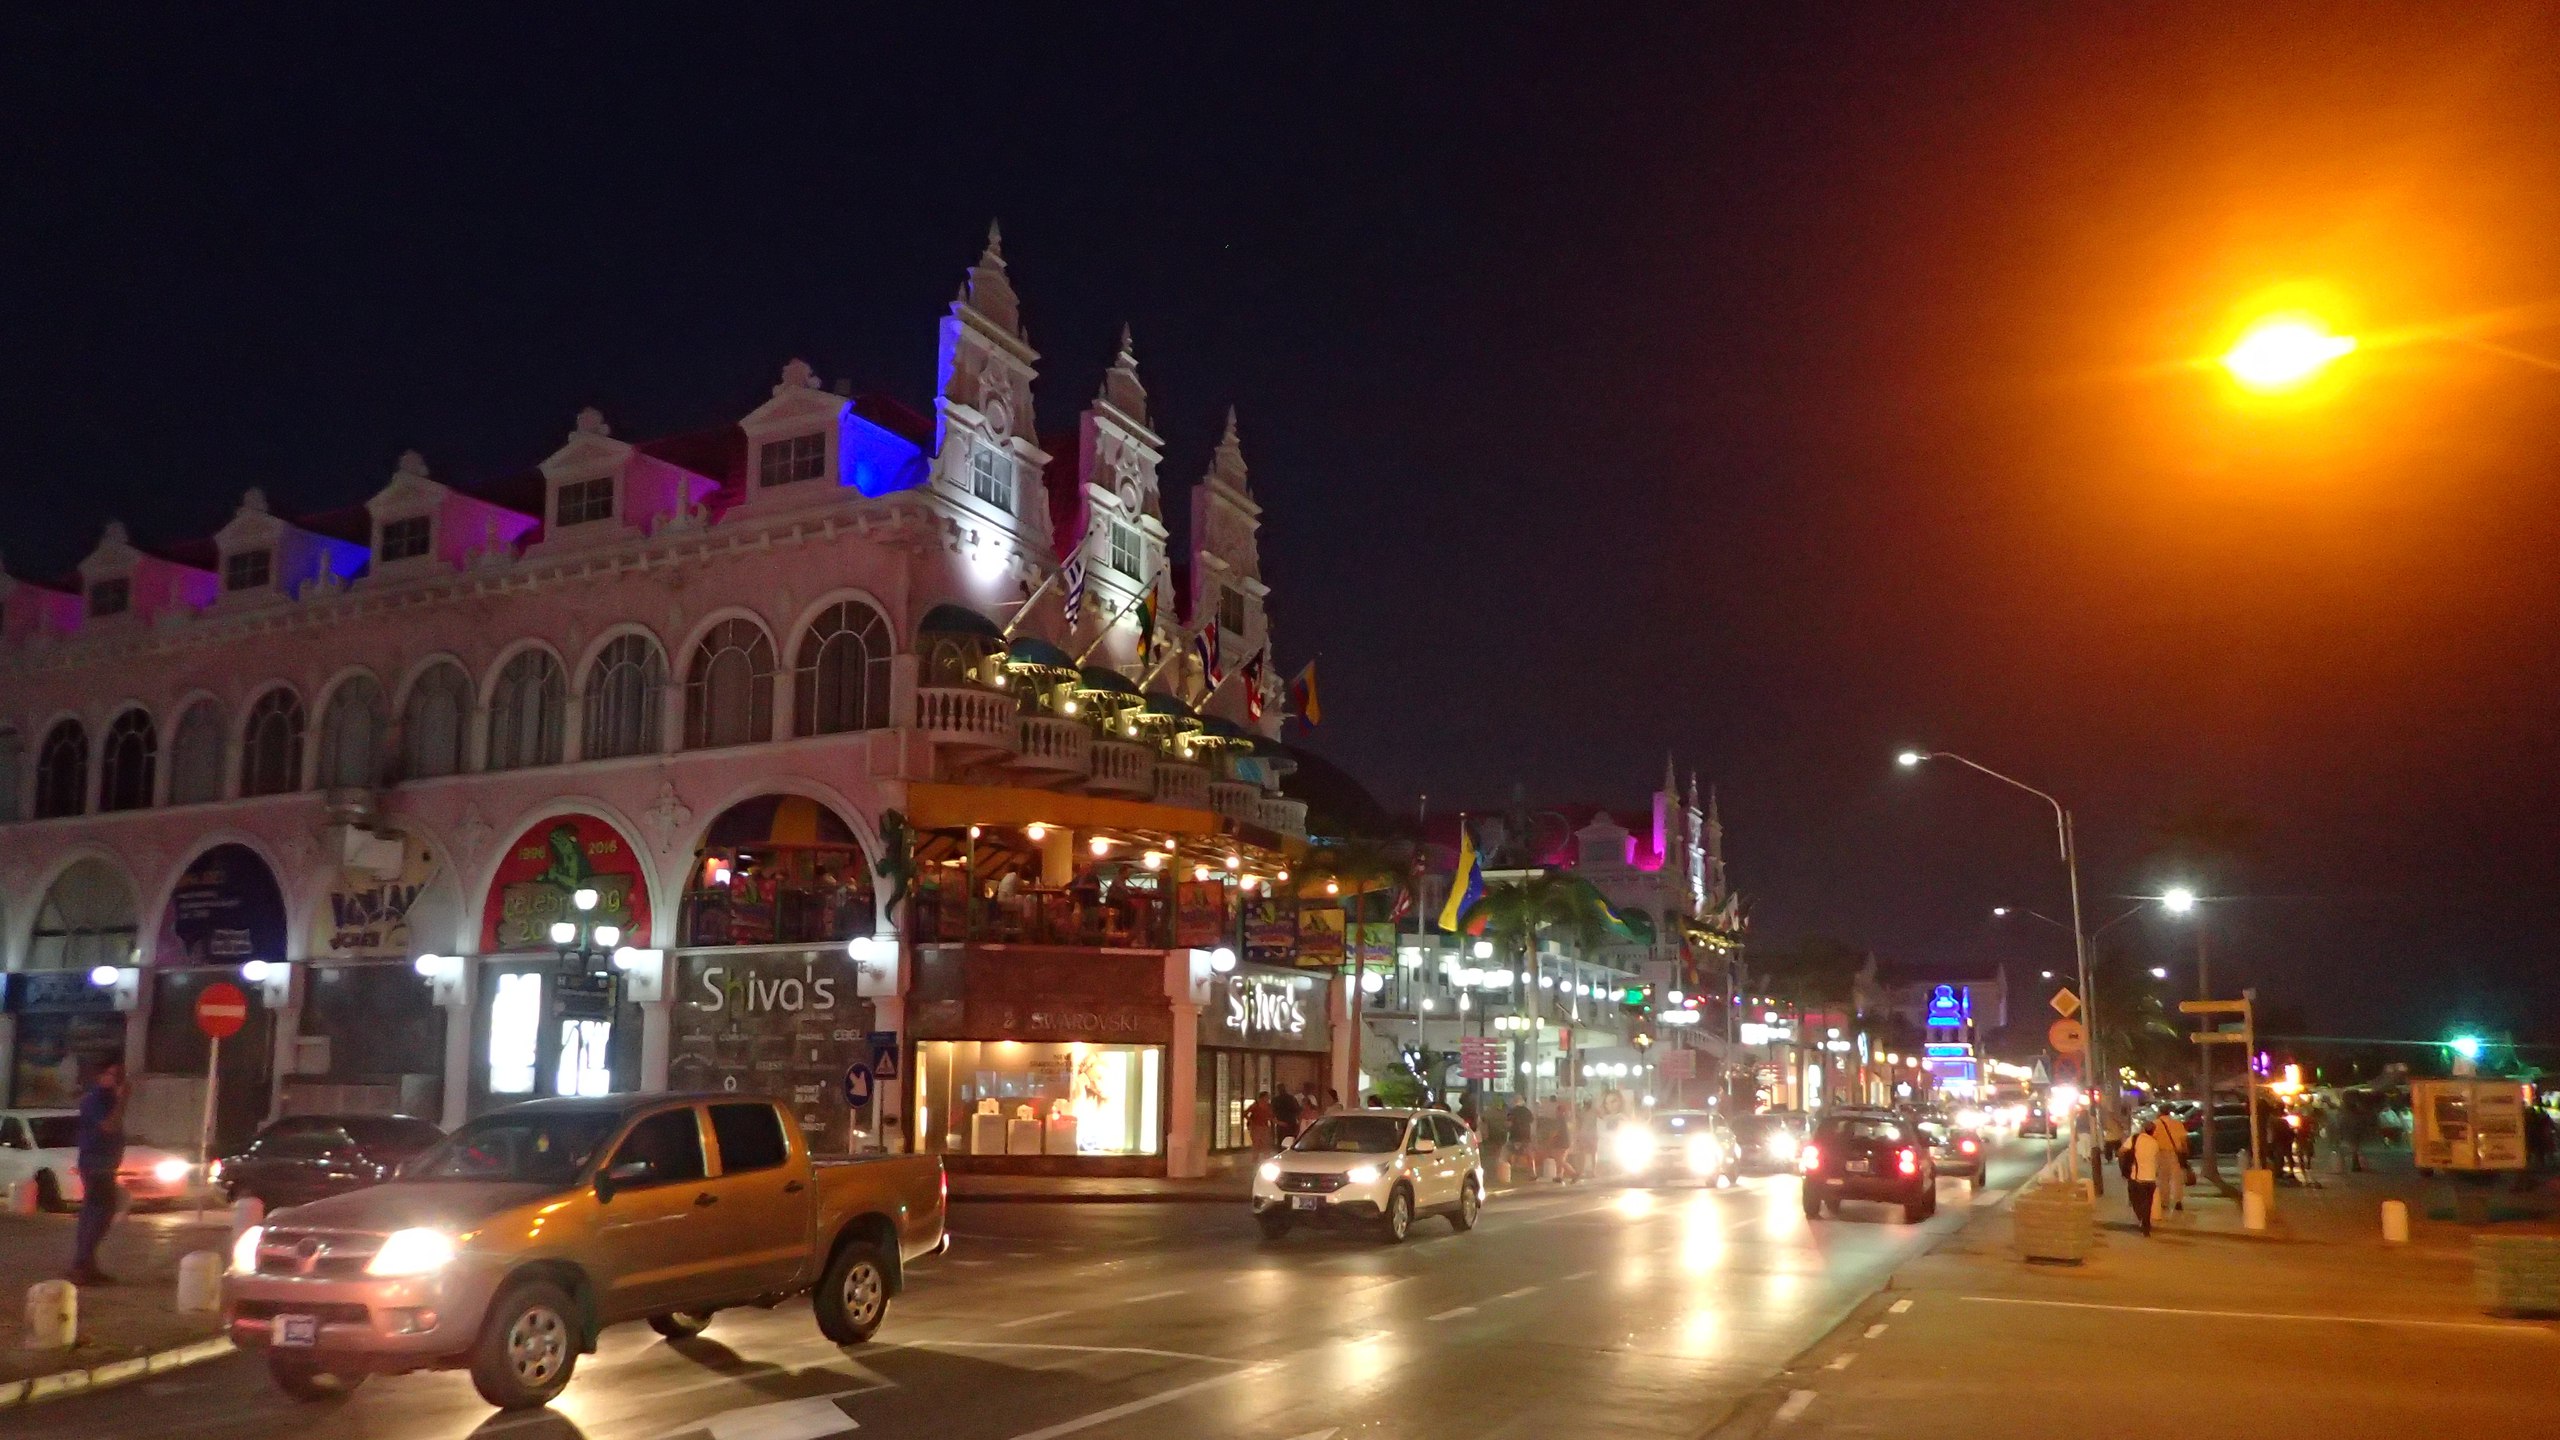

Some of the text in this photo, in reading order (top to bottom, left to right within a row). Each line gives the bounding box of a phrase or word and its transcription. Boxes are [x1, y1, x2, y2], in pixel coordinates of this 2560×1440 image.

[700, 965, 835, 1014] Shiva's
[1227, 975, 1306, 1036] Shiva's
[1031, 1012, 1139, 1031] SWAROVSKI
